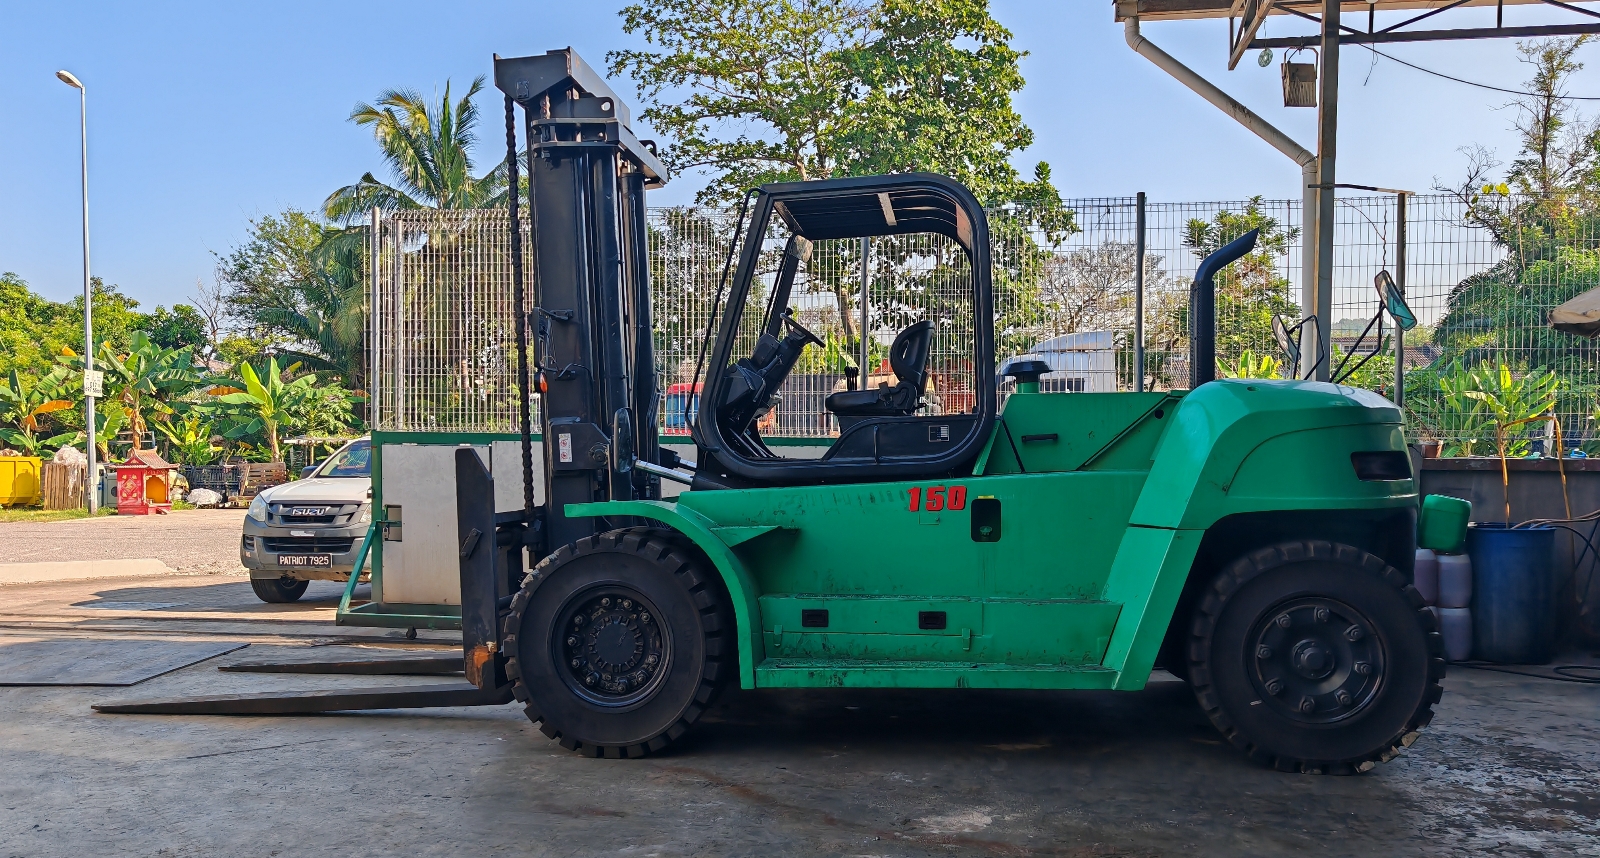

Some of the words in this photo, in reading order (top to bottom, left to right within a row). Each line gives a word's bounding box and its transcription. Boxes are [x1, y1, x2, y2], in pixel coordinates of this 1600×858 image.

[907, 485, 967, 512] 150
[279, 555, 307, 565] PATRIOT
[309, 555, 329, 565] 7925
